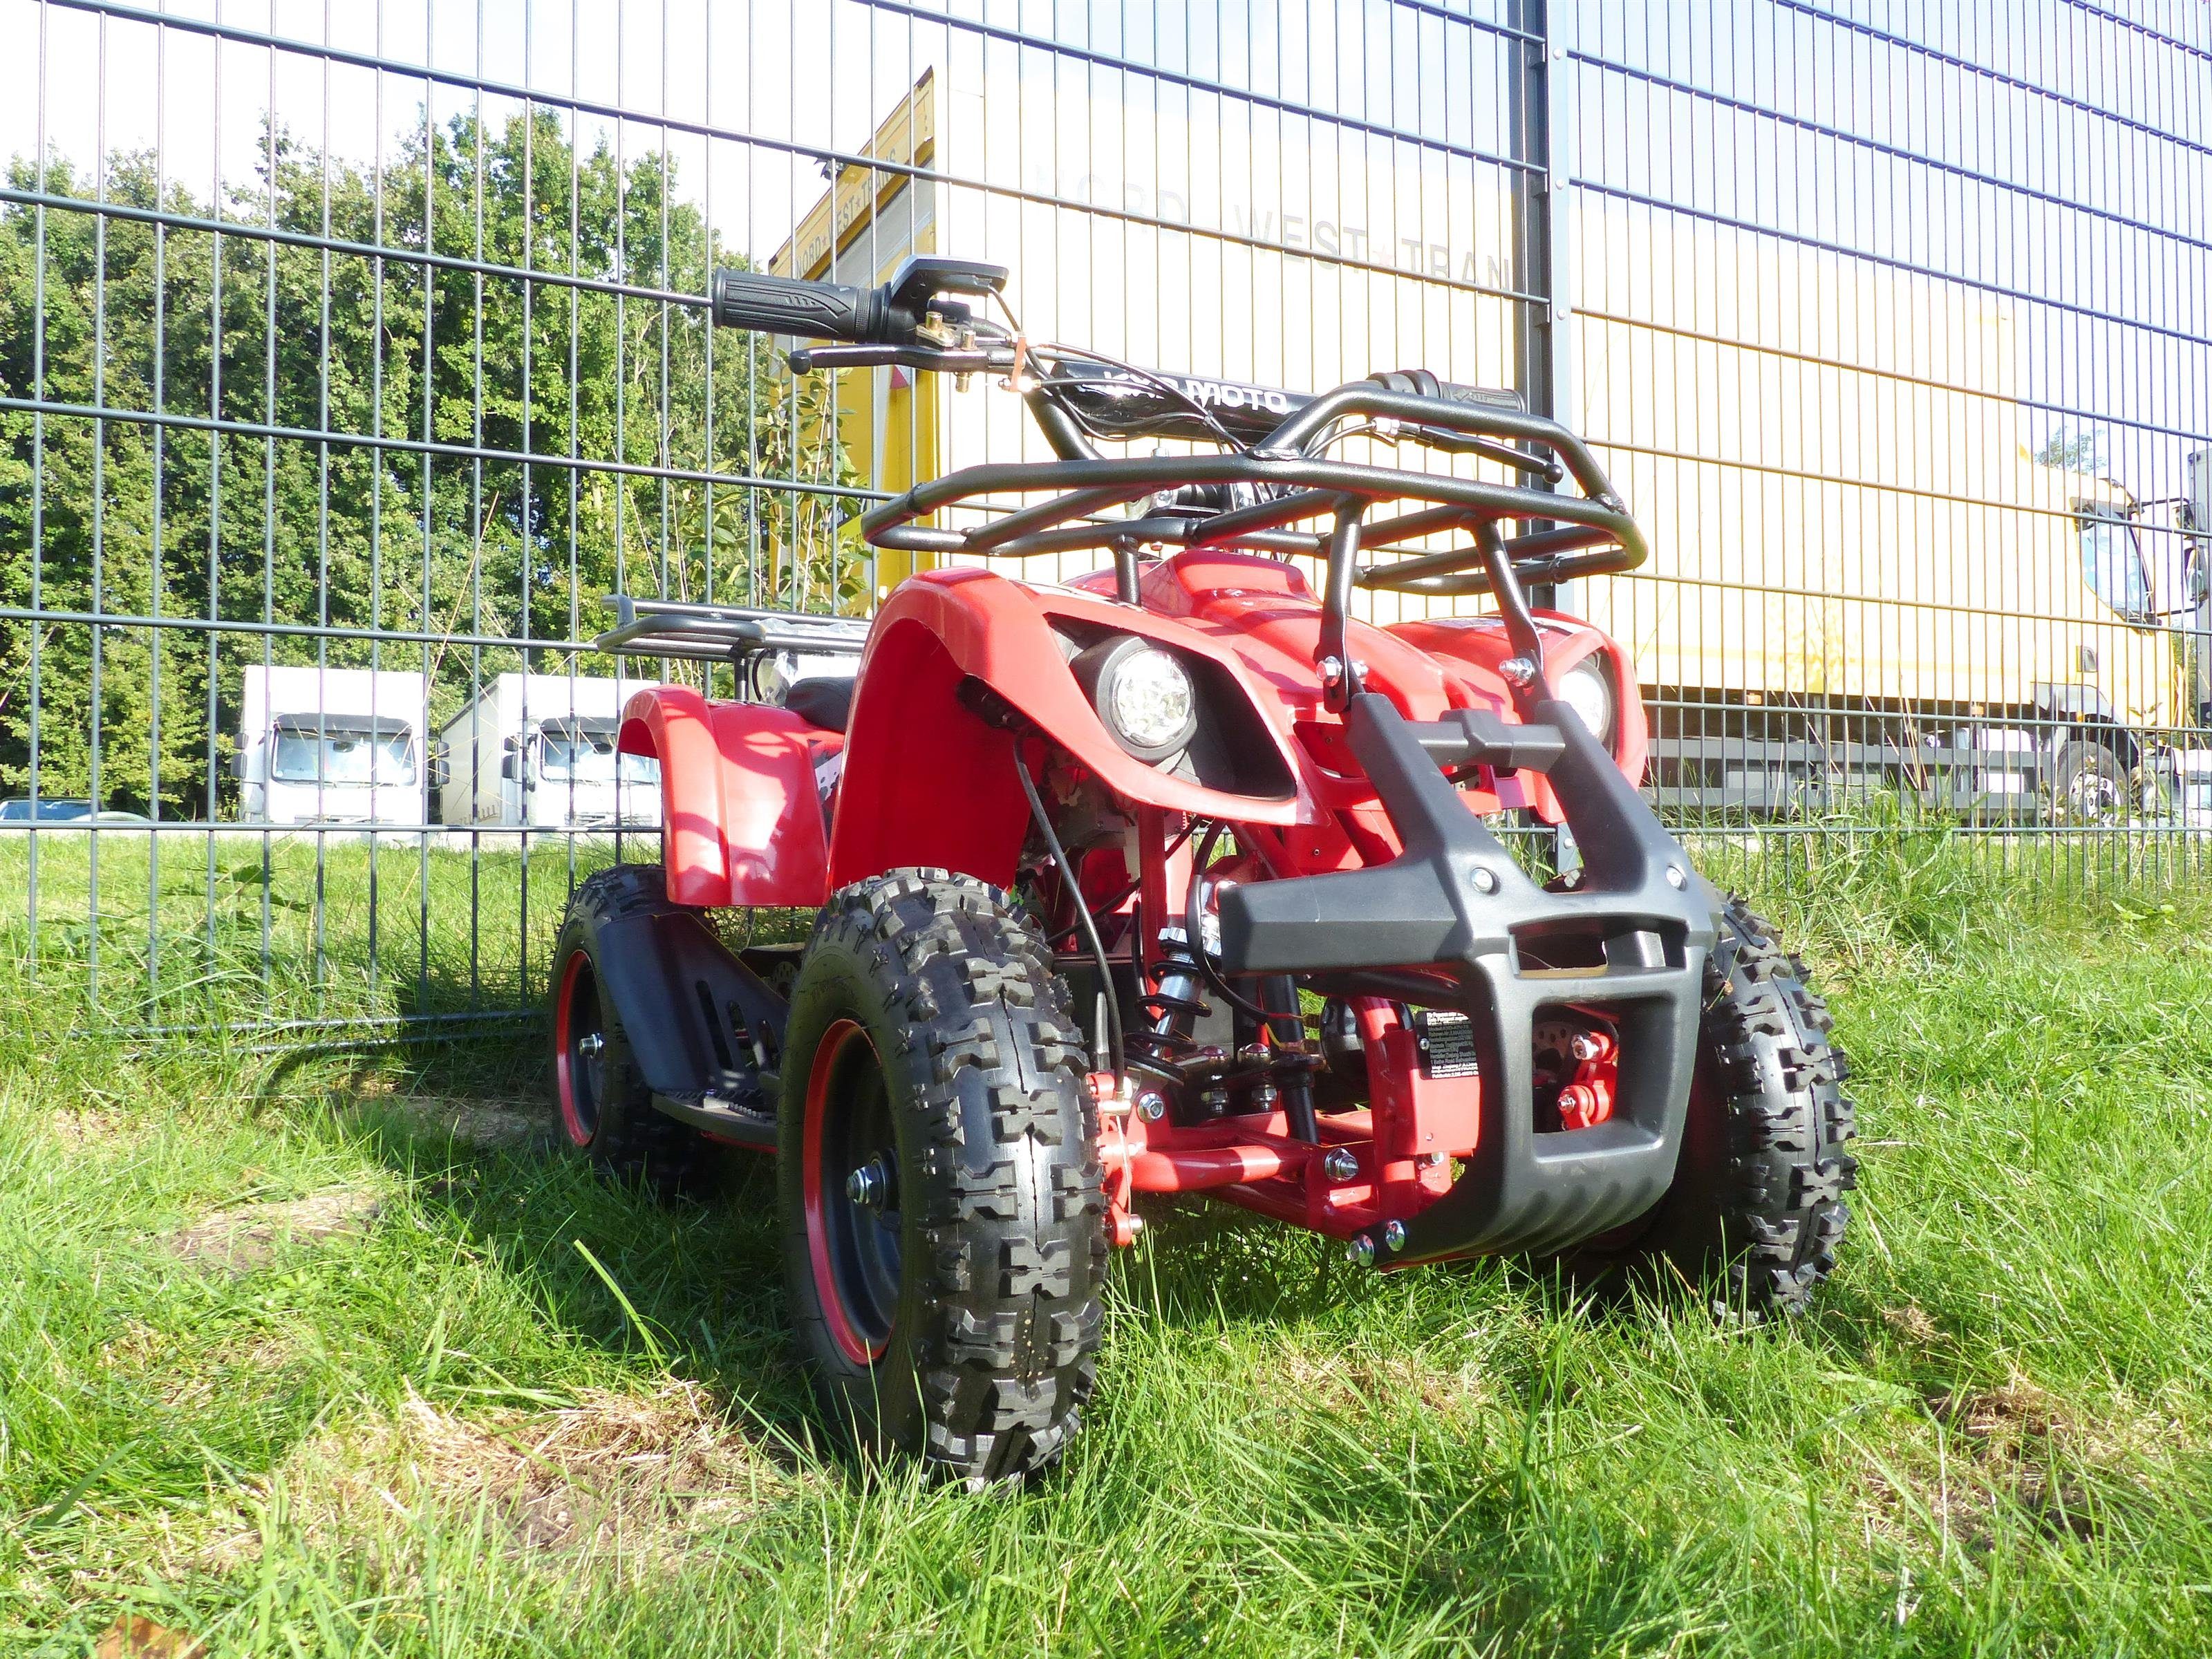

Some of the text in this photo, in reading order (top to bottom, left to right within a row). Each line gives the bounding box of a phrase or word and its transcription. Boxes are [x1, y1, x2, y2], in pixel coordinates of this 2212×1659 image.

[795, 236, 822, 279] NORD
[1234, 205, 1370, 273] WEST
[1184, 379, 1288, 415] MOTO
